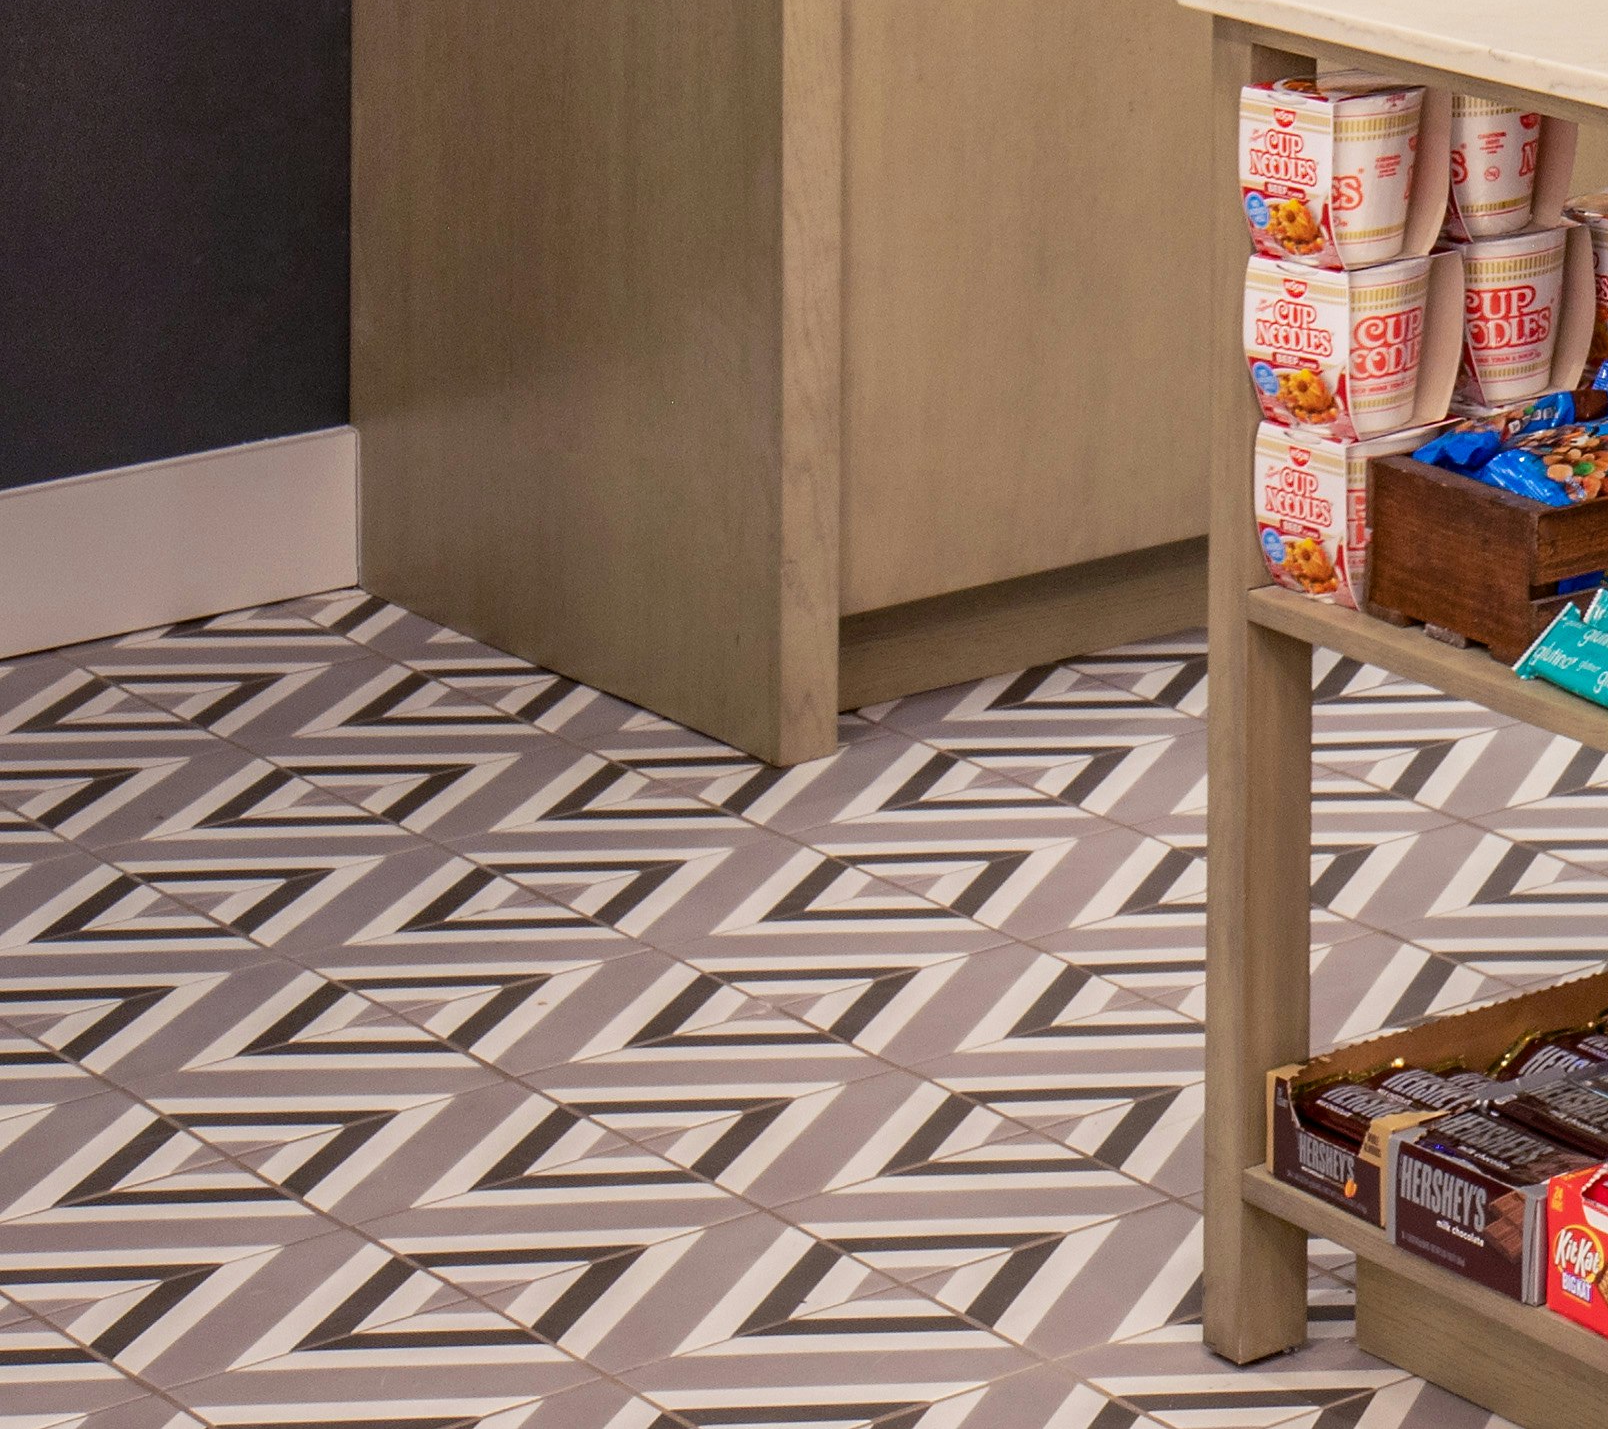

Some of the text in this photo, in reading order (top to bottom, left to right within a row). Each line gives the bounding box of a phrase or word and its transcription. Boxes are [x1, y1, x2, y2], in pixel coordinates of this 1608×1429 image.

[1264, 129, 1304, 159] CUP
[1249, 147, 1318, 186] NOODLES
[1272, 299, 1317, 329] CUP
[1255, 319, 1334, 357] NOODLES
[1278, 466, 1319, 494] CUP
[1264, 488, 1333, 527] NOODLES
[1297, 1134, 1358, 1185] HERSHEY'S
[1398, 1154, 1491, 1233] HERSHEY'S
